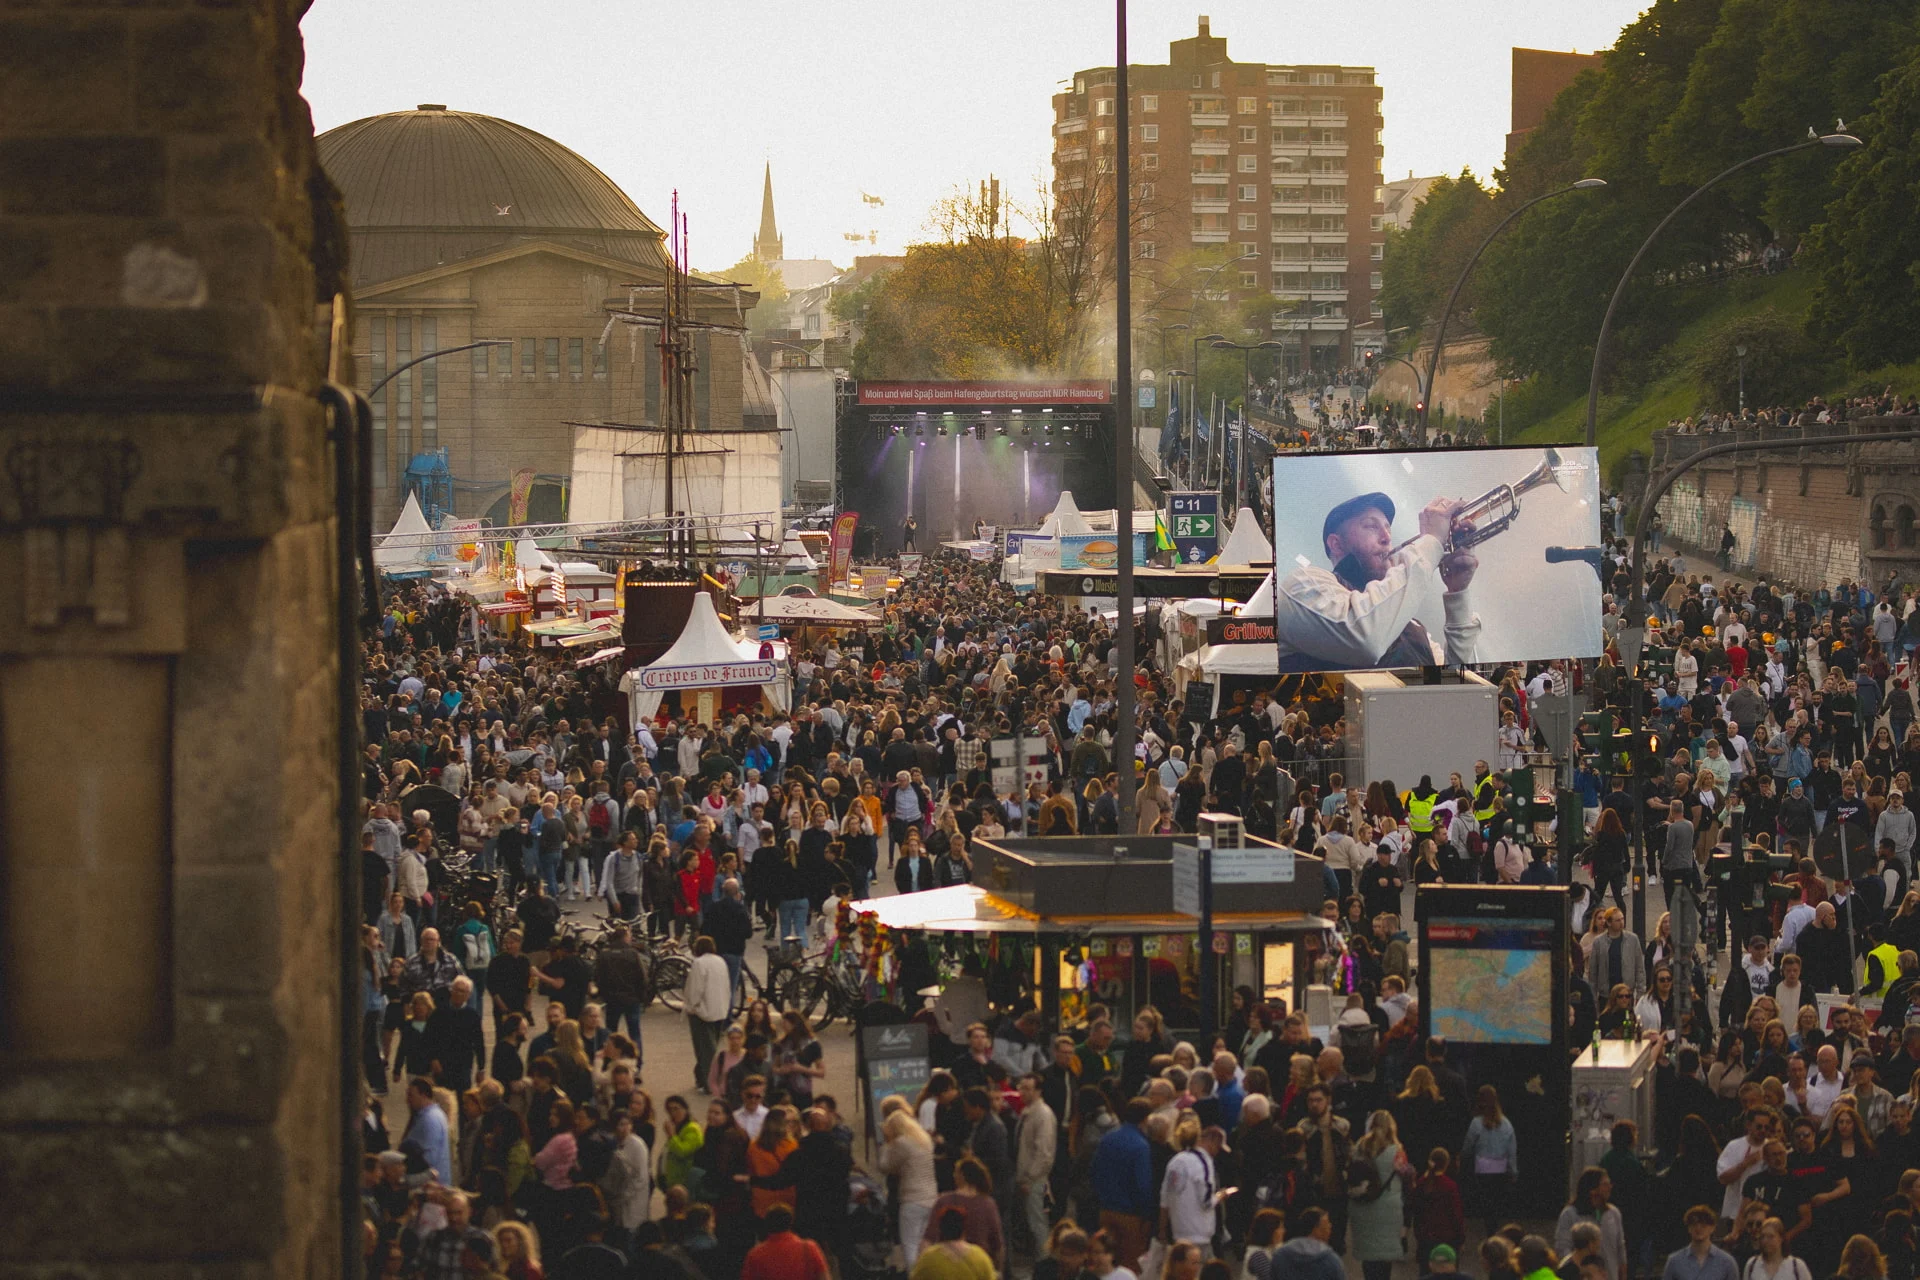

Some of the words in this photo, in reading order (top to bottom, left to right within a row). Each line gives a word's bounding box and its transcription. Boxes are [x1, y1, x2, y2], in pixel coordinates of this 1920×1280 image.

[865, 389, 883, 398] Moin
[885, 389, 898, 398] und
[900, 389, 913, 398] viel
[914, 389, 933, 400] Spaß
[935, 389, 953, 398] beim
[954, 389, 1018, 400] Hafengeburtstag
[1020, 389, 1051, 398] wünscht
[1053, 388, 1068, 397] NDR
[1070, 388, 1104, 399] Hamburg
[1187, 499, 1200, 511] 11
[646, 669, 697, 686] Crêpes
[703, 667, 718, 681] de
[720, 665, 772, 682] France
